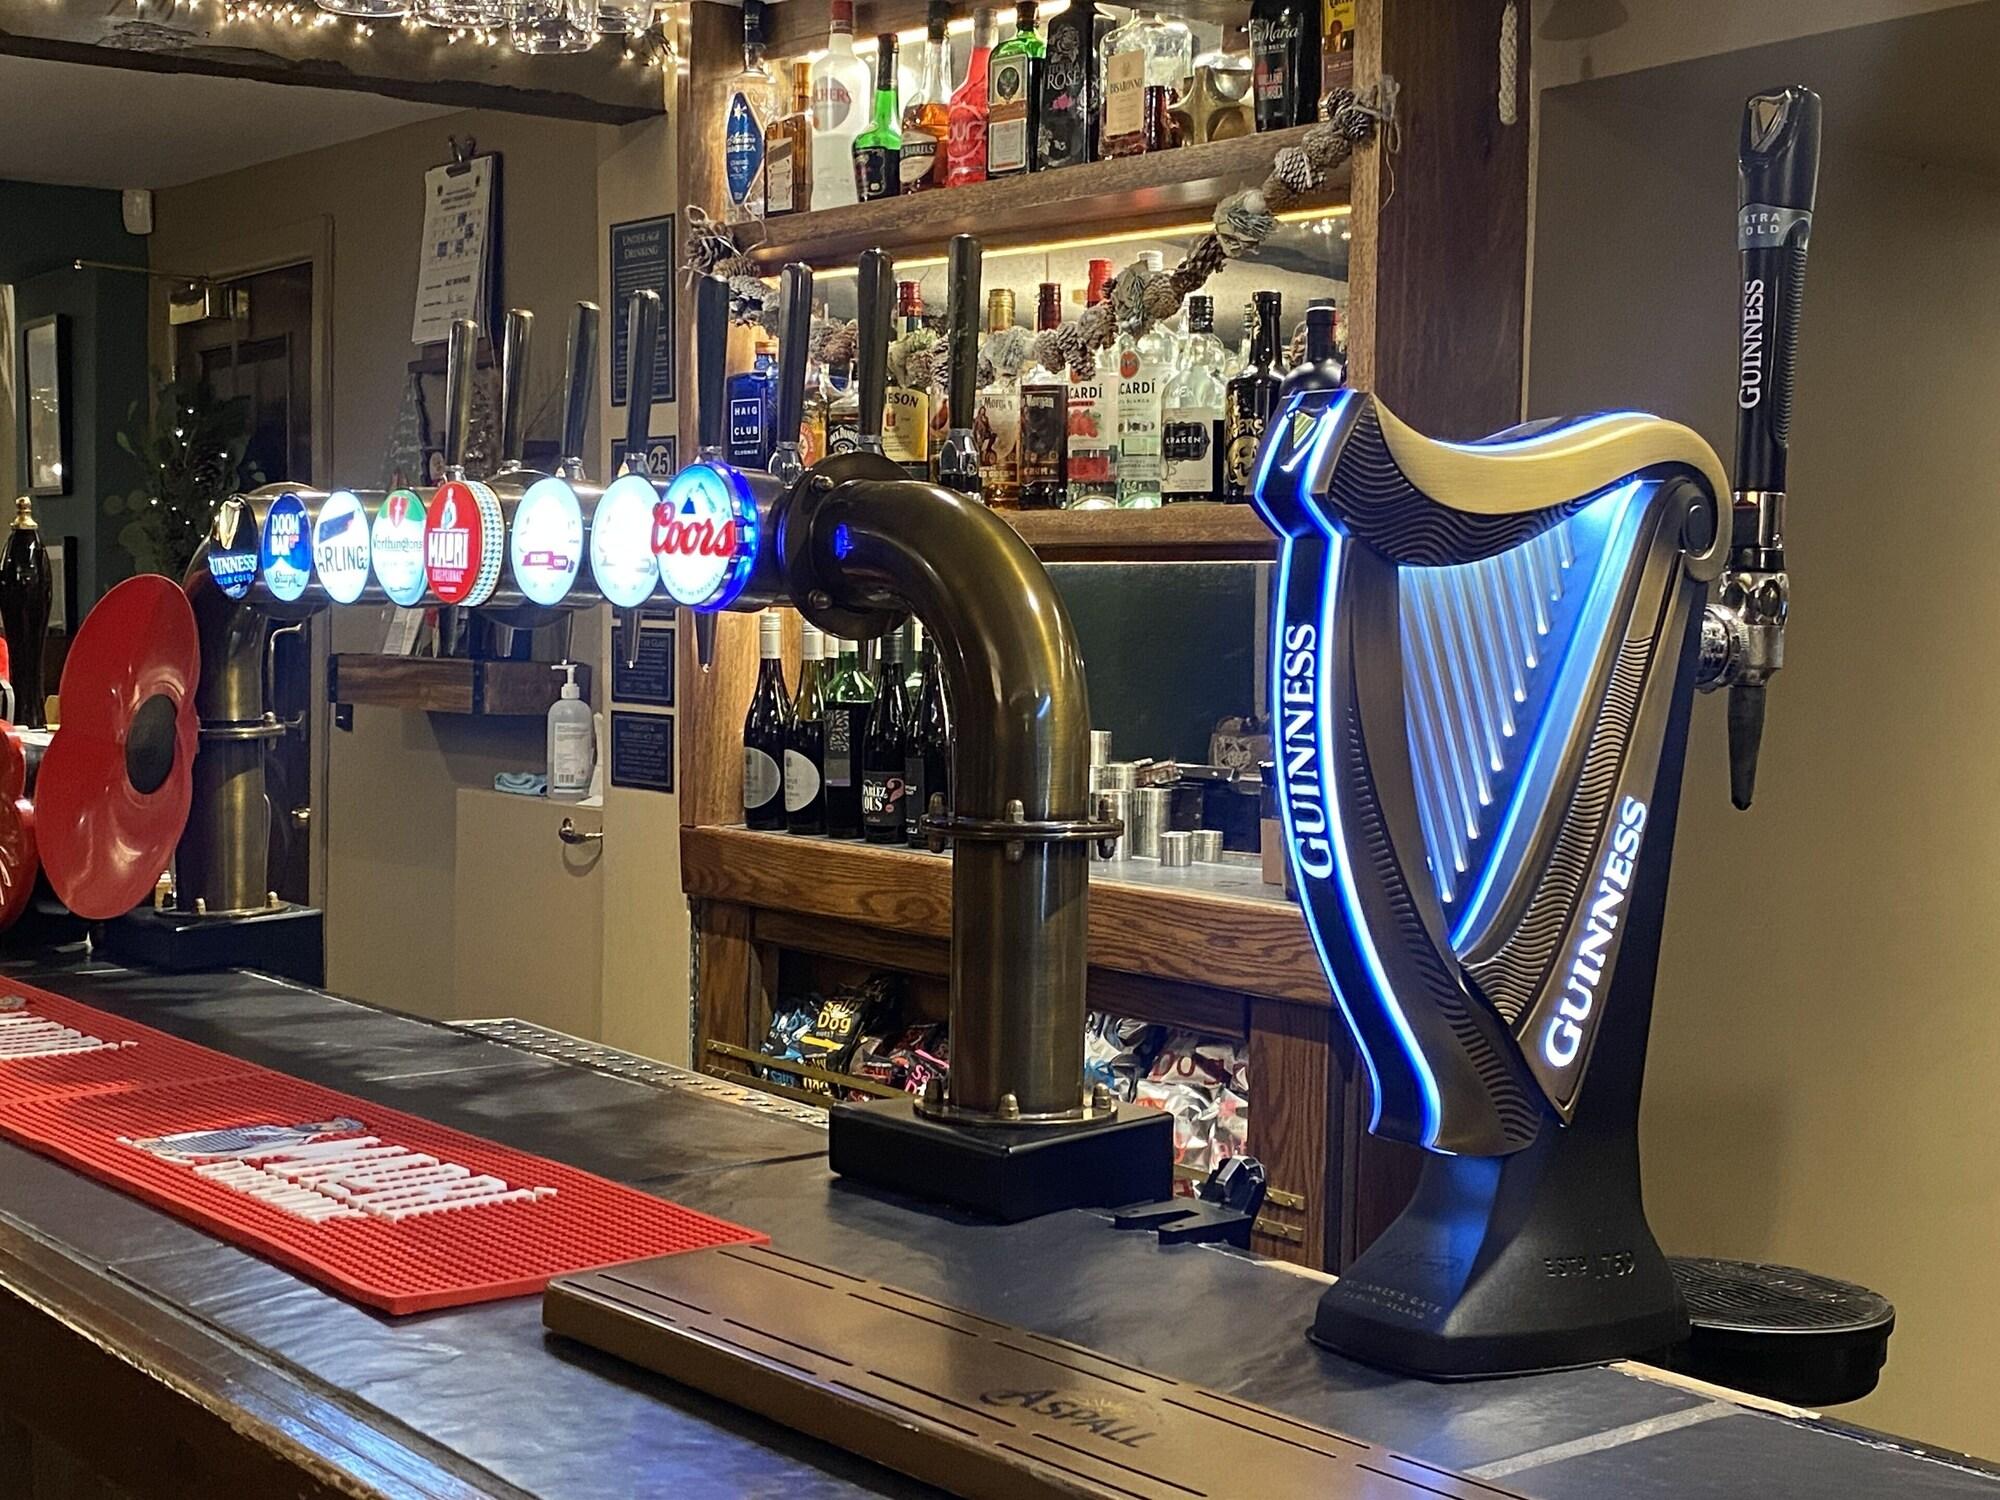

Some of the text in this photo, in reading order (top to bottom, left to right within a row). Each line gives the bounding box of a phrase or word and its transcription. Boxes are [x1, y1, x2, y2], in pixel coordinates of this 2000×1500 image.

[1047, 70, 1080, 90] ROSE
[1744, 213, 1781, 224] XTRA
[1745, 225, 1780, 236] OLD
[1738, 279, 1765, 410] GUINNESS
[1069, 383, 1103, 400] CARDÍ
[1119, 377, 1156, 396] CARDÍ
[887, 392, 920, 409] ESON
[734, 406, 758, 416] HAIG
[734, 426, 758, 436] CLUB
[1165, 435, 1201, 445] KRAKEN
[651, 452, 668, 476] 25
[271, 514, 300, 535] DOOM
[651, 501, 737, 557] Coors
[317, 545, 368, 572] ARLING
[1283, 622, 1334, 880] GUINNESS
[863, 784, 886, 799] ARLEZ
[863, 797, 883, 812] OUS
[1545, 795, 1648, 1069] GUINNESS
[817, 1011, 852, 1034] Dog
